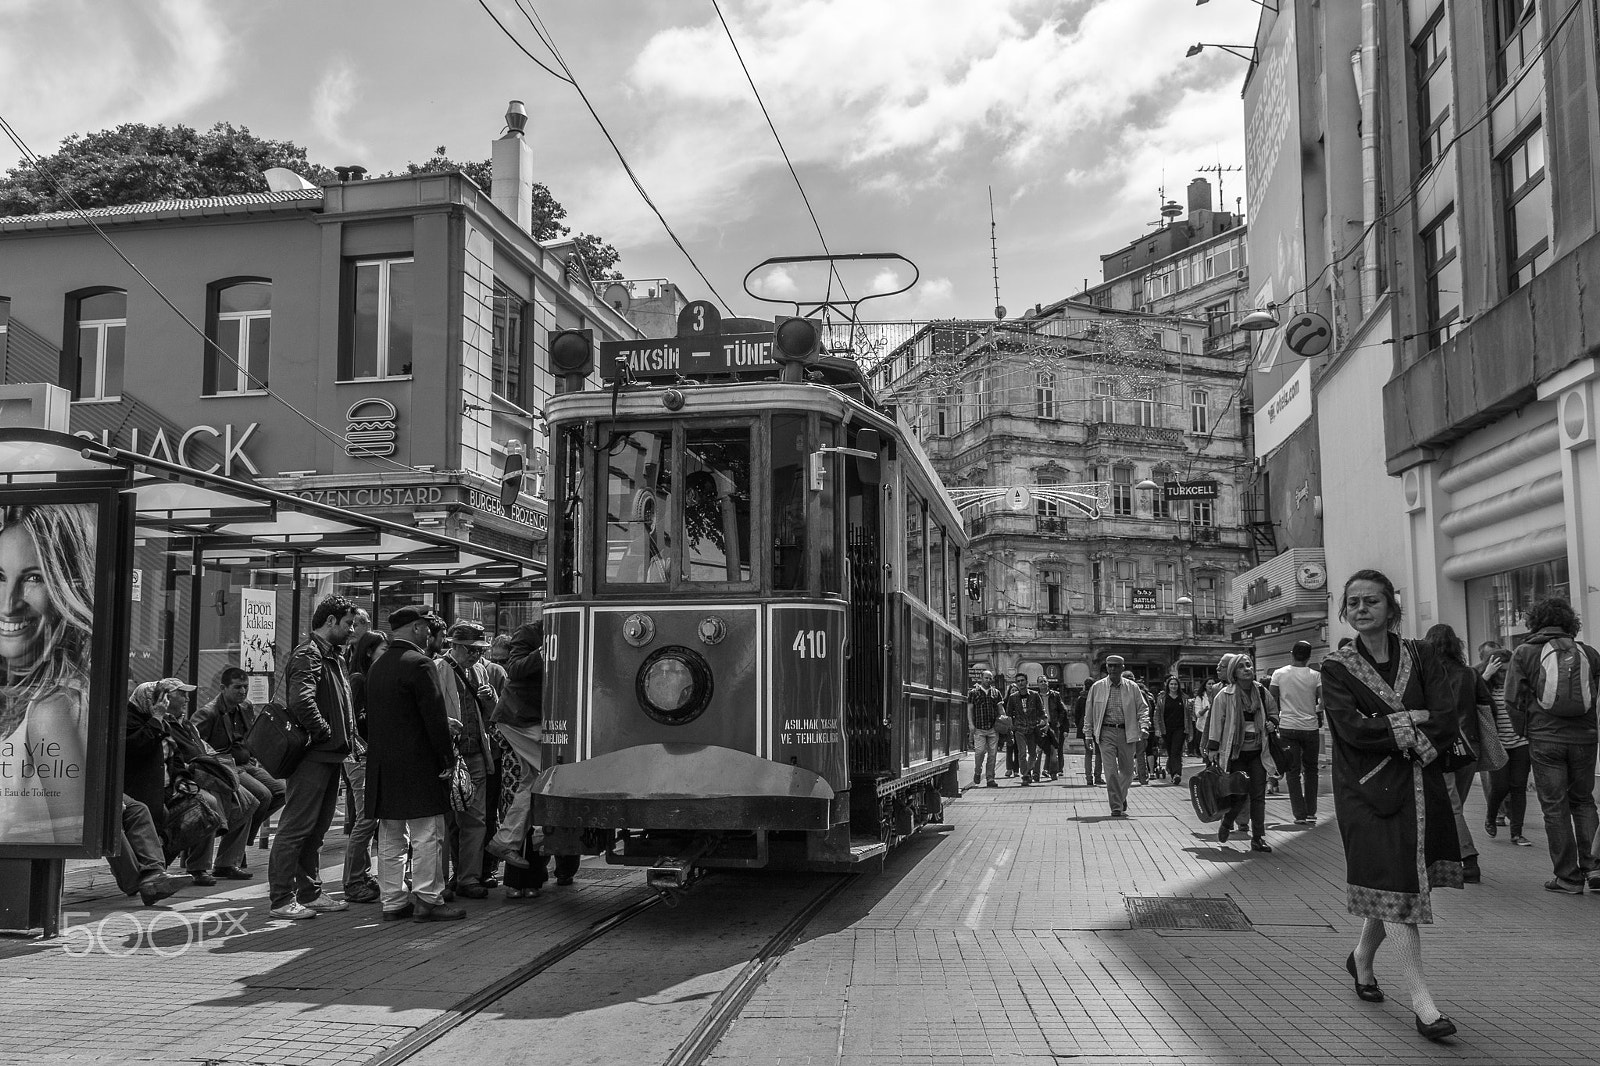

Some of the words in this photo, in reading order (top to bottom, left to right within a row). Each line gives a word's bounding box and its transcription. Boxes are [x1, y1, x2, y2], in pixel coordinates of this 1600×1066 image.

[692, 305, 705, 332] 3
[355, 487, 442, 505] CUSTARD
[1167, 485, 1215, 496] TURKCELL
[511, 503, 539, 526] FROZEN
[243, 598, 272, 620] Japon
[792, 630, 826, 659] 410
[820, 718, 838, 730] YASAK
[0, 742, 14, 757] a
[24, 738, 61, 757] vie
[780, 732, 792, 744] VE
[21, 759, 80, 779] belle
[4, 787, 19, 797] Eau
[20, 787, 31, 797] de
[31, 787, 61, 798] Toilette
